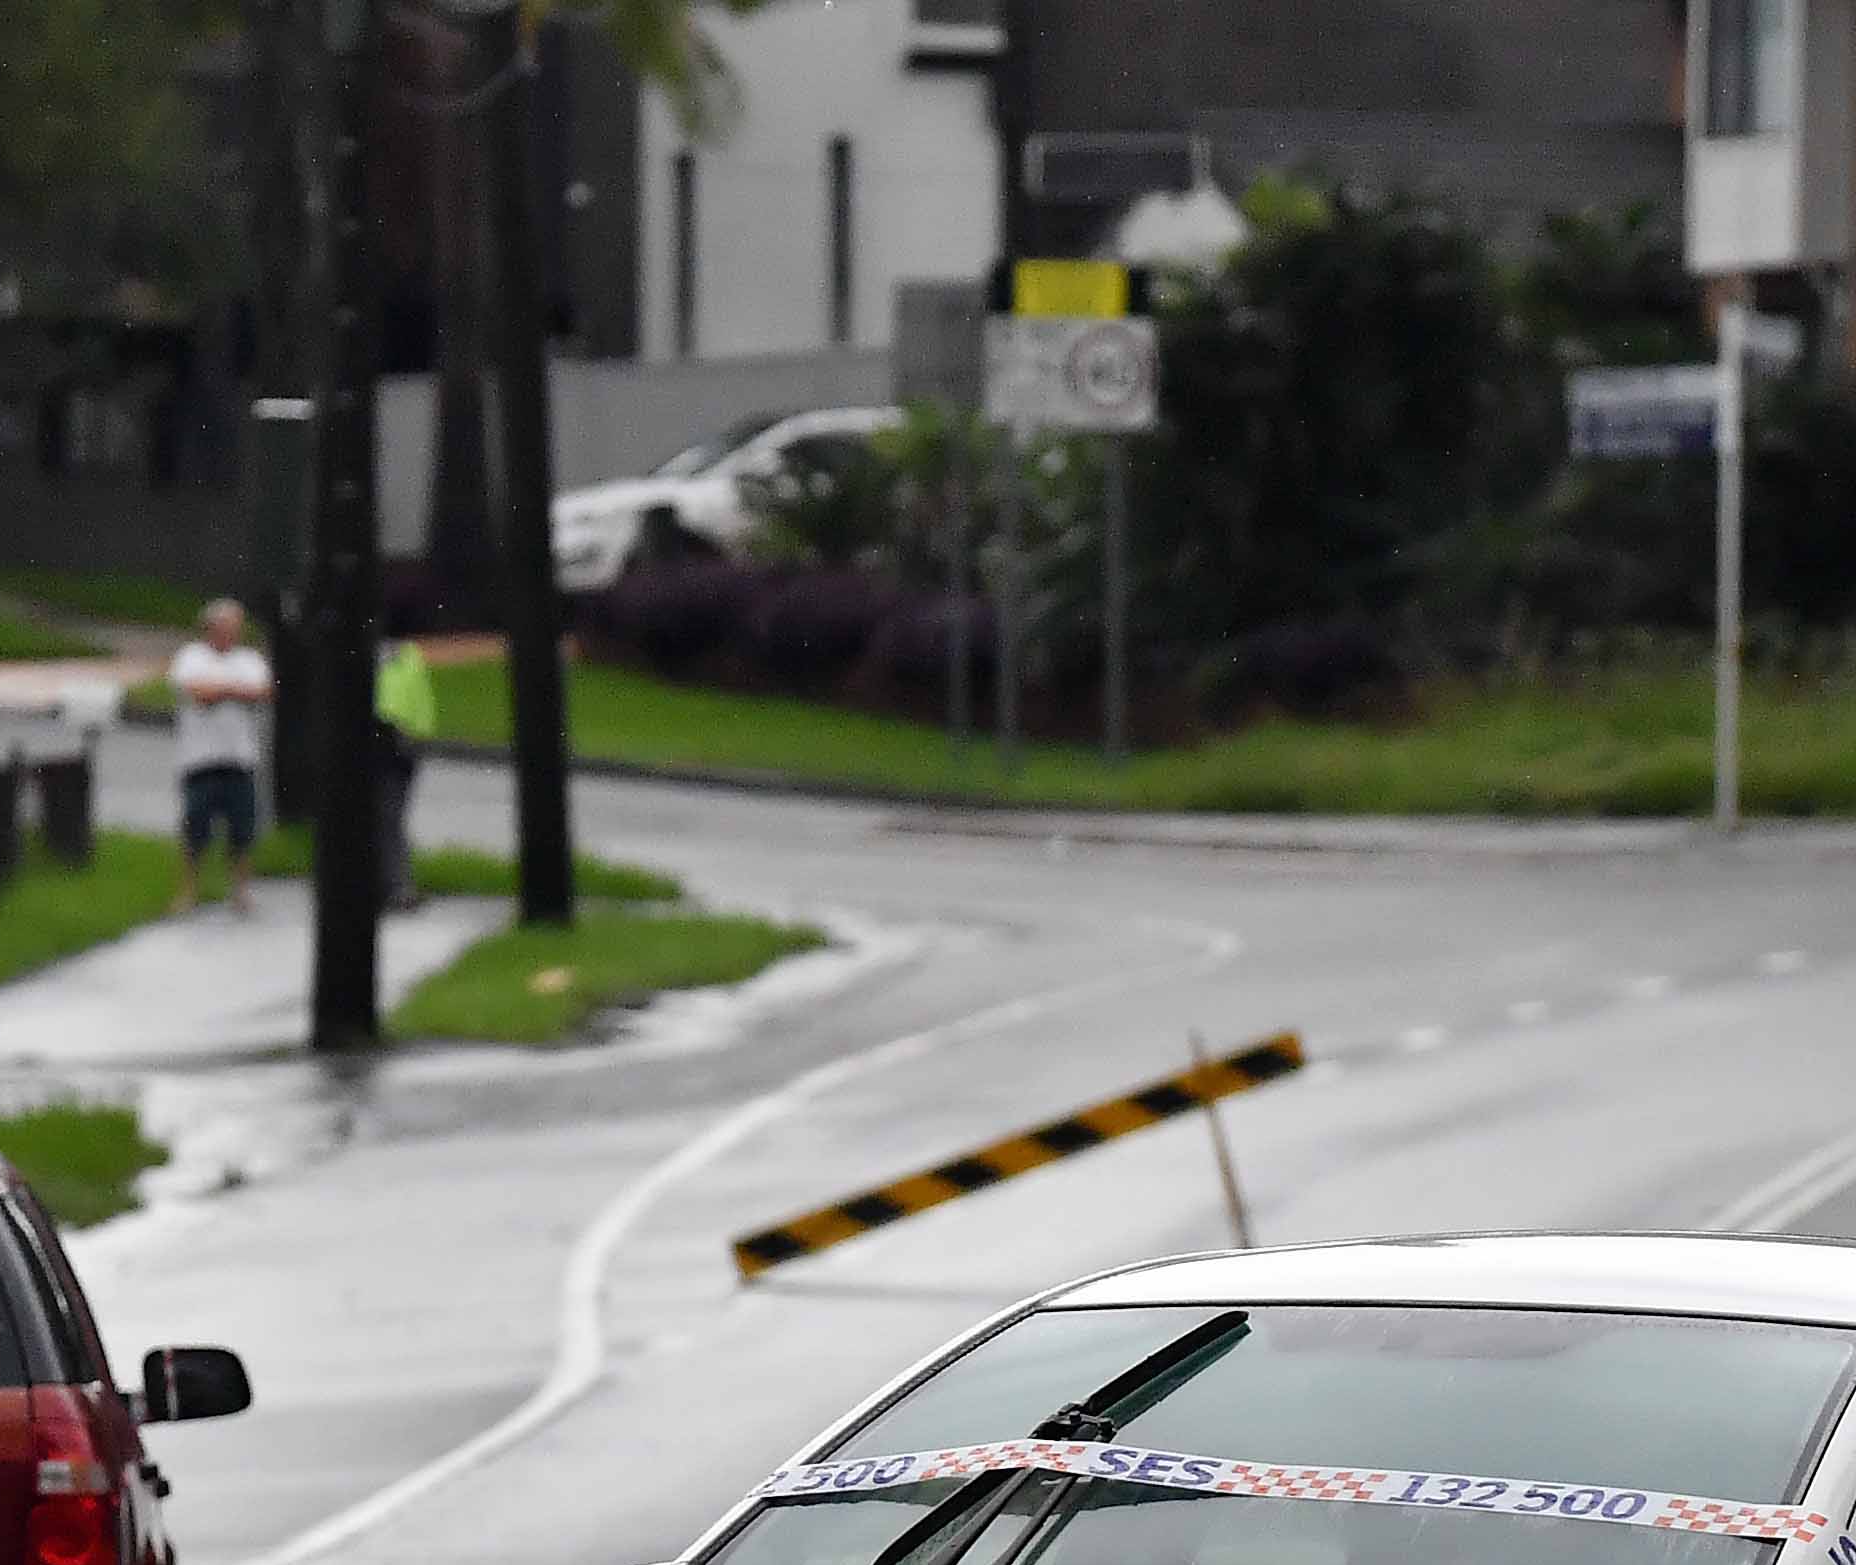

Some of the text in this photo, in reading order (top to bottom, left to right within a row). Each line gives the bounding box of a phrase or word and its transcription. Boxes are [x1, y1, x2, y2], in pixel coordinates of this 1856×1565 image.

[791, 1456, 916, 1491] 500
[1087, 1448, 1223, 1486] SES
[1388, 1474, 1647, 1519] 132 500
